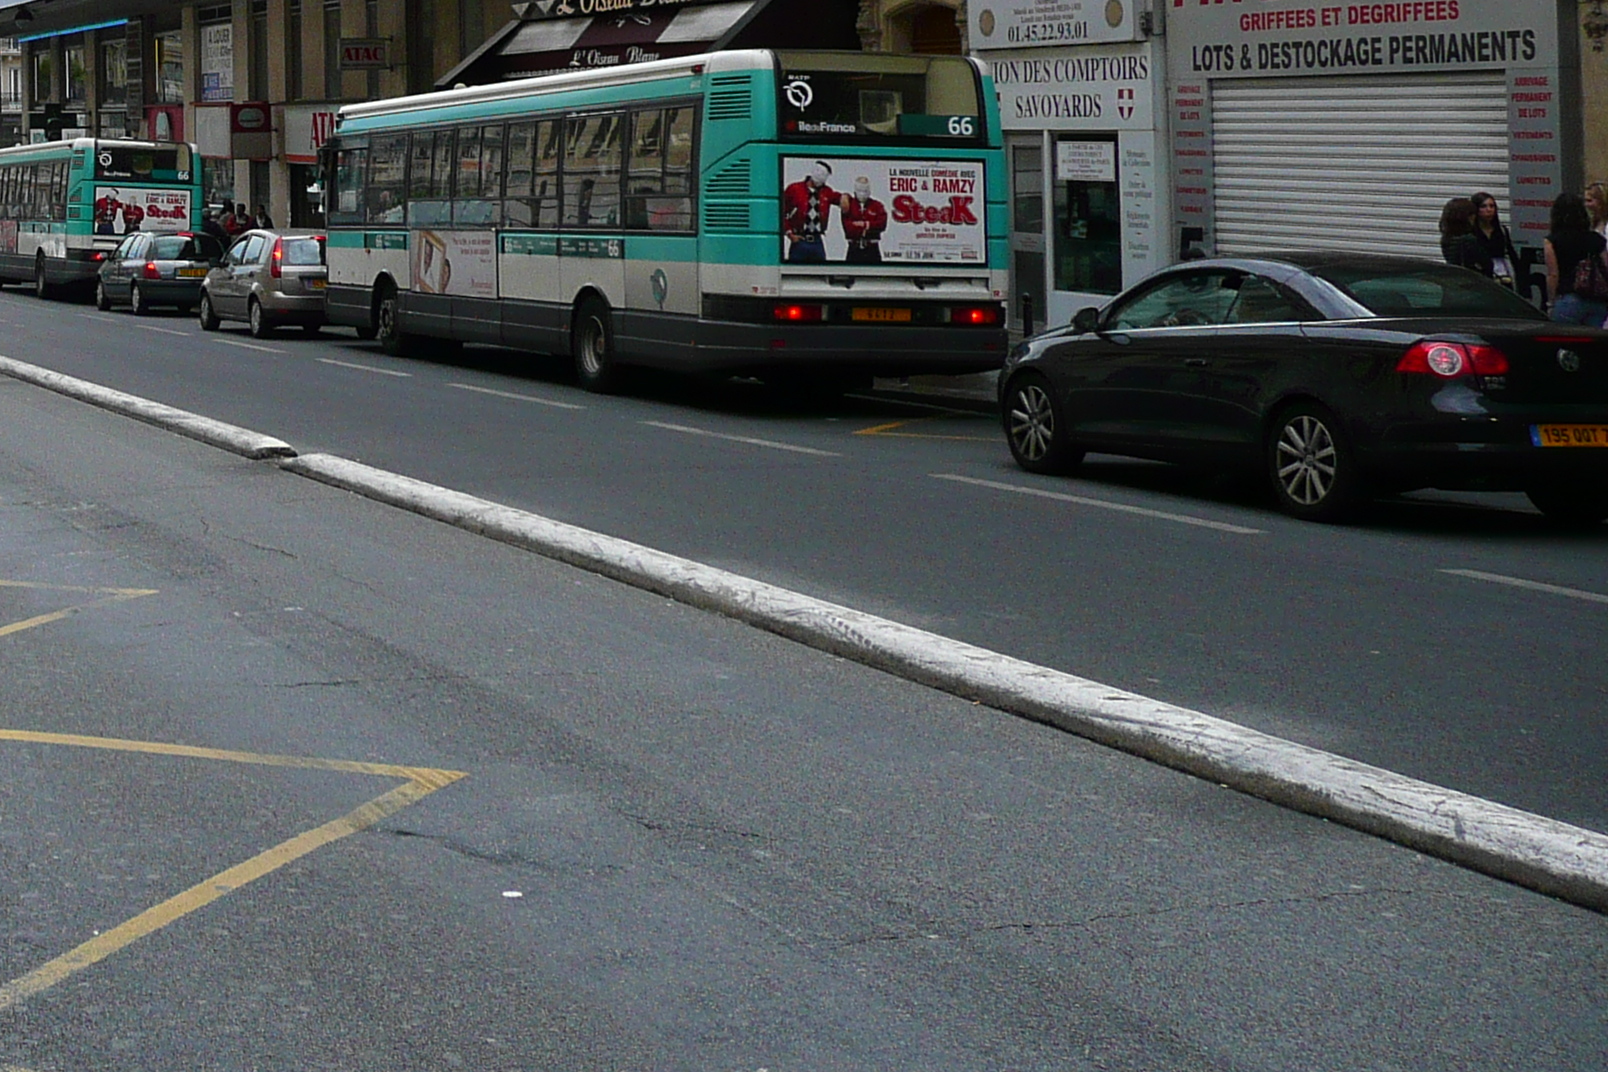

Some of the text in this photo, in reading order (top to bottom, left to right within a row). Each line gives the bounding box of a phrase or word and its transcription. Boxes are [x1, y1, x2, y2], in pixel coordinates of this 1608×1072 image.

[1239, 0, 1459, 32] GRIFFEES ET DEGRIFFEES
[1008, 21, 1088, 42] 01.45.22.93.01
[343, 46, 385, 62] ATAC
[1193, 29, 1535, 72] LOTS & DESTOCKAGE PERMANENTS
[992, 55, 1148, 84] ION DES COMPTOIRS
[1015, 93, 1102, 119] SAVOYARDS
[948, 116, 973, 135] 66
[177, 171, 189, 180] 66
[889, 168, 897, 176] LA
[899, 168, 929, 177] NOUVELLE
[960, 170, 976, 178] AVEC
[890, 177, 976, 194] ERIC & RAMZY
[608, 240, 620, 257] 66
[1544, 429, 1570, 443] 195
